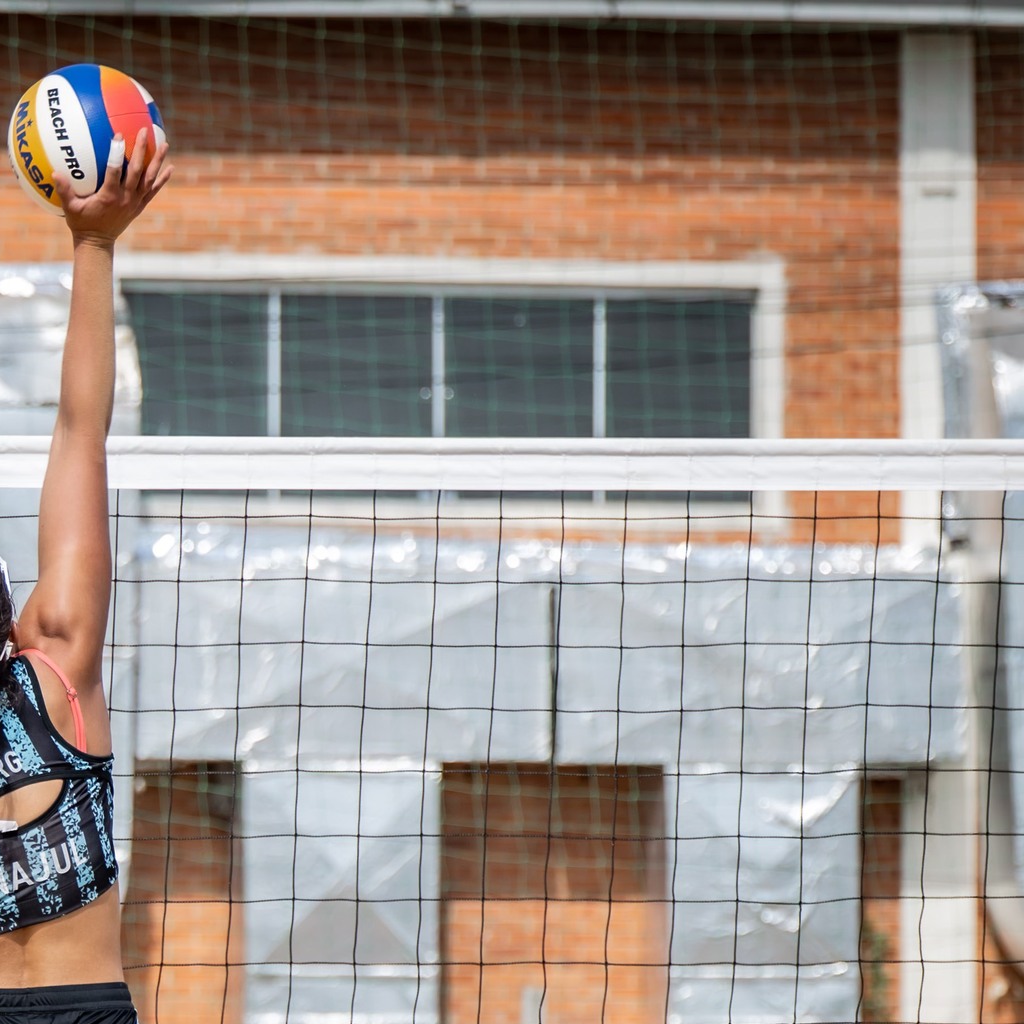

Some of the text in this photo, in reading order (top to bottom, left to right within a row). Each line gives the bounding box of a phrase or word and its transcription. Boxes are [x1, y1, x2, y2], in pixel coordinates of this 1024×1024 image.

[15, 101, 55, 199] MIKASA
[47, 88, 85, 180] BEACH PRO
